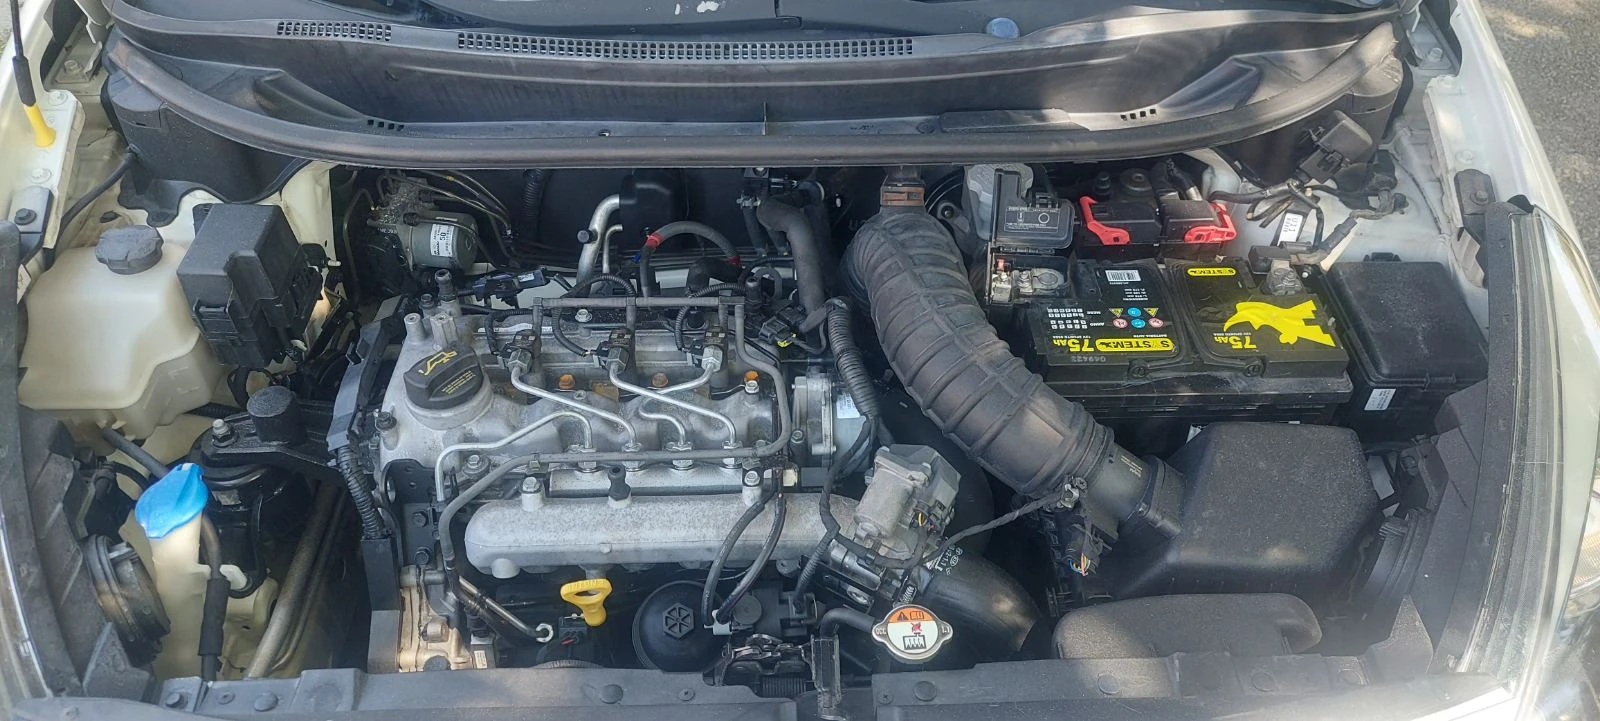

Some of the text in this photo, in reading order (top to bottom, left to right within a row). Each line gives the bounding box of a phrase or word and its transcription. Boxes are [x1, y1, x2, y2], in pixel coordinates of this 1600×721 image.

[1052, 338, 1170, 352] SYSTEM 75Ah
[1214, 336, 1257, 349] 75Ah
